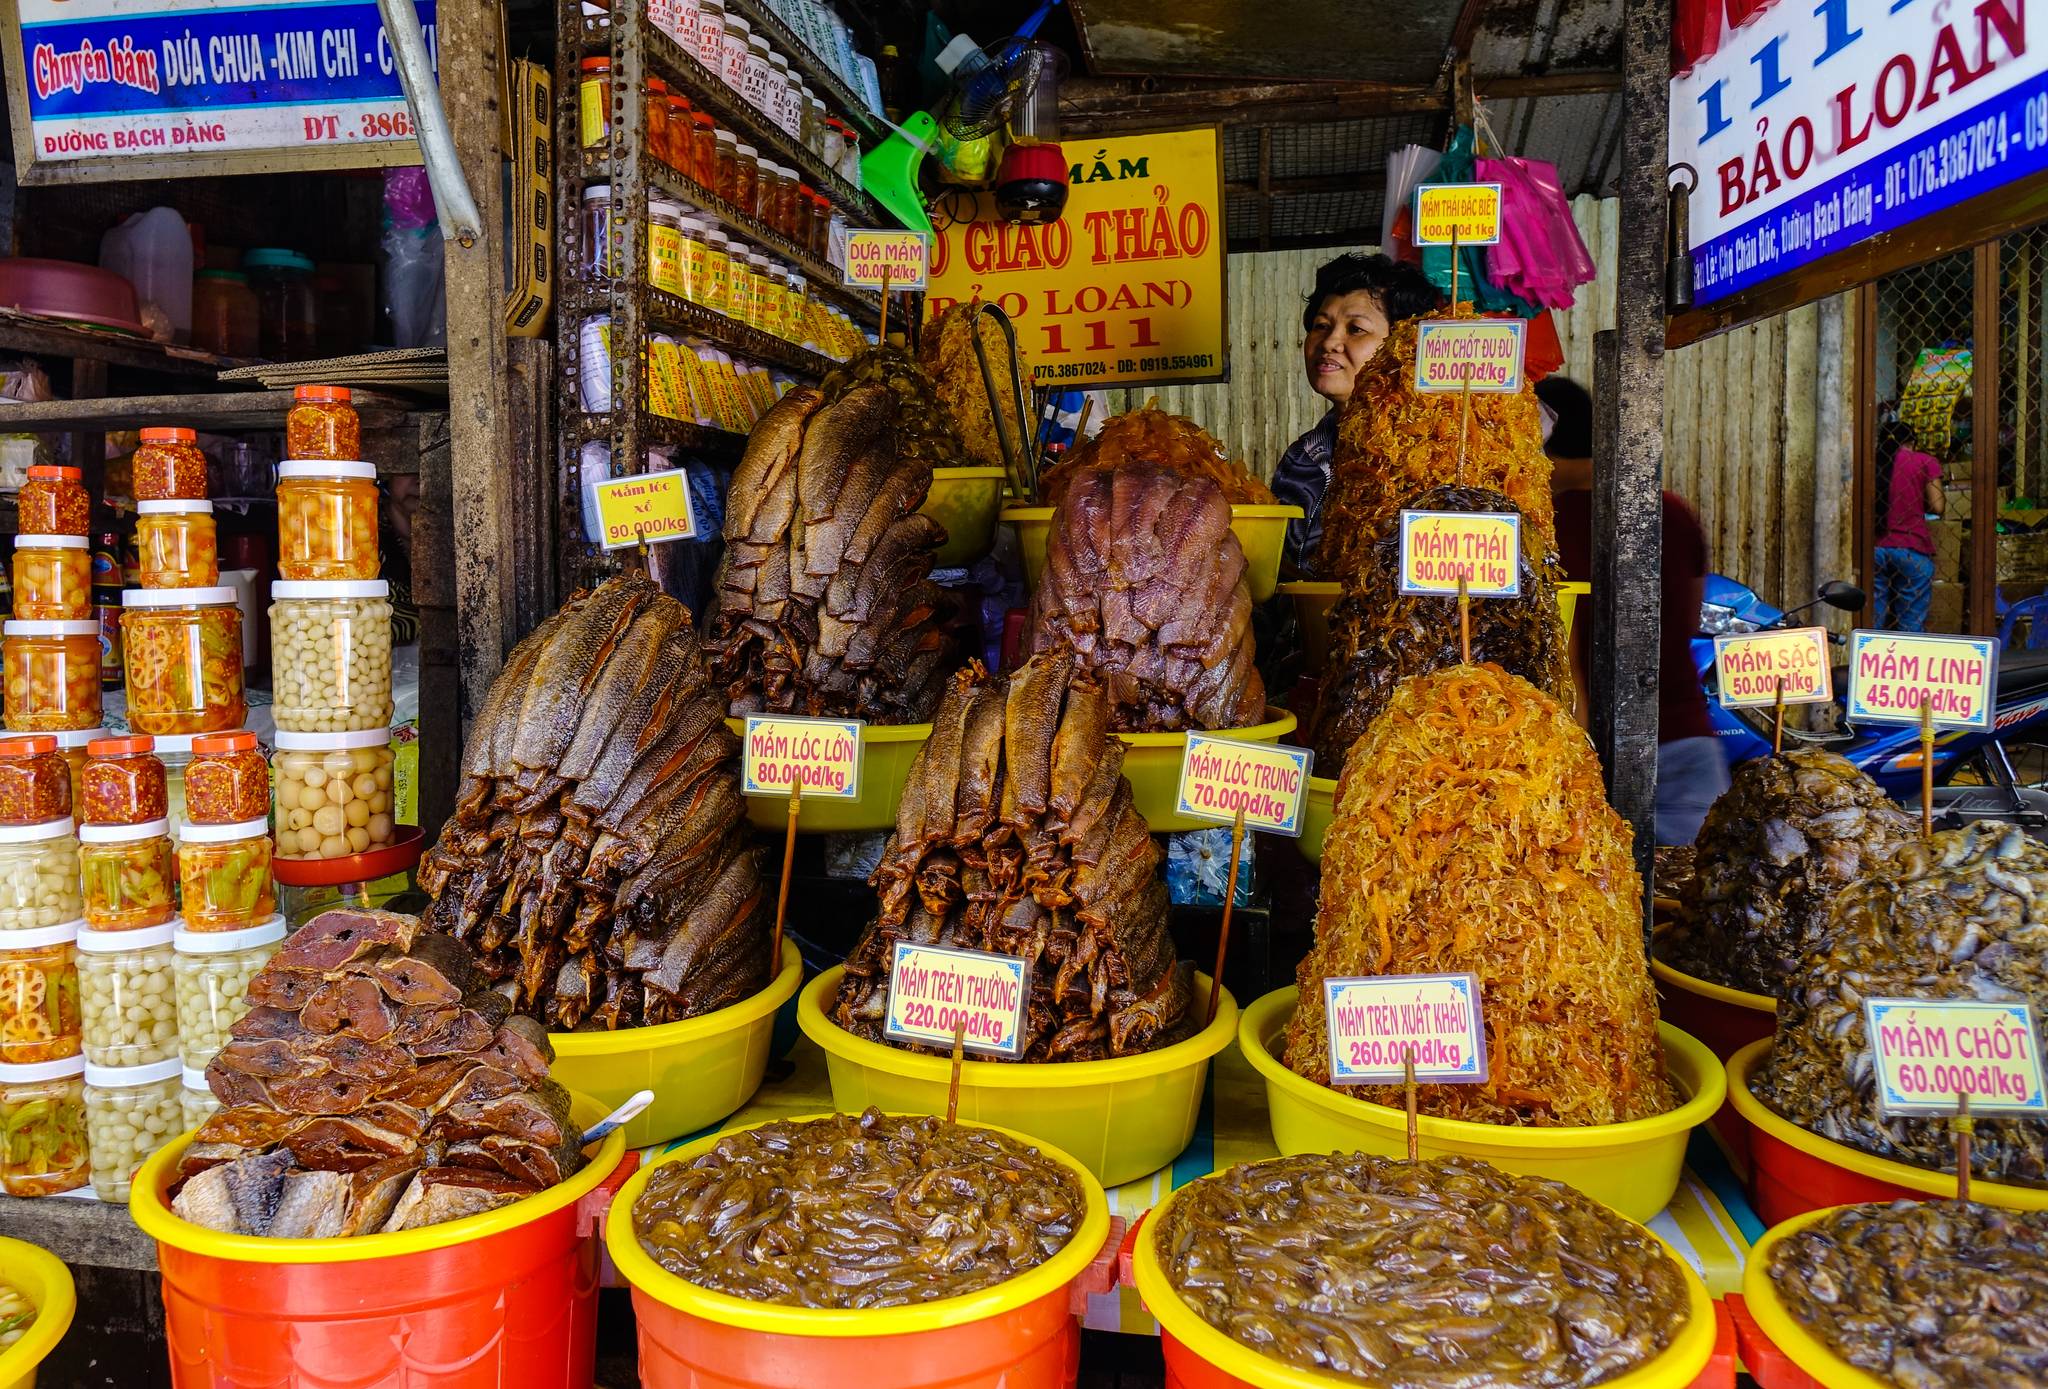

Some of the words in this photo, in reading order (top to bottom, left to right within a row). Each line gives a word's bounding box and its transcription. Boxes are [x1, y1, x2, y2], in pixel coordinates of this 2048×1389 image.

[35, 38, 109, 99] Chuyên
[209, 31, 265, 84] CHUA
[321, 28, 359, 79] CHI
[1718, 116, 1814, 218] BẢO
[1837, 0, 2027, 156] LOAN
[44, 128, 109, 153] ĐƯỜNG
[113, 127, 165, 151] BẠCH
[172, 117, 226, 145] ĐẰNG
[1068, 149, 1150, 185] MẮM
[1735, 232, 1757, 274] Châu
[1814, 191, 1841, 248] Bạch
[1909, 110, 2008, 201] 076.3867024
[1083, 184, 1210, 266] THẢO
[1423, 223, 1472, 237] 100.00đ
[1475, 223, 1495, 237] 1kg
[850, 241, 881, 261] DƯA
[885, 236, 922, 262] MẮM
[1043, 280, 1192, 316] LOAN)
[1425, 329, 1451, 359] MẮM
[1452, 329, 1480, 359] CHỐT
[1482, 338, 1497, 359] ĐU
[1034, 360, 1106, 380] 076.3867024
[1140, 353, 1214, 373] 0919.554961
[609, 517, 688, 539] 90.000/kg
[1413, 519, 1458, 559] MẮM
[1463, 527, 1508, 561] THÁI
[1479, 562, 1507, 588] 1kg
[1723, 641, 1772, 674] MẮM
[1778, 642, 1818, 673] SẶC
[1860, 641, 1920, 682] MẮM
[1926, 656, 1984, 686] LINH
[752, 724, 788, 759] MẮM
[792, 731, 821, 761] LÓC
[824, 733, 854, 763] LỚN
[1714, 728, 1747, 737] ONDA
[758, 762, 845, 791] 80.000đ/kg
[1188, 743, 1222, 782] MẮM
[1223, 754, 1251, 786] LÓC
[1254, 763, 1299, 794] TRUNG
[1194, 783, 1286, 823] 70.000đ/kg
[897, 952, 928, 999] MẮM
[931, 964, 964, 1004] TRÈN
[967, 970, 1017, 1013] THƯỜNG
[903, 1001, 1003, 1044] 220.000đ/kg
[1337, 991, 1366, 1037] MẮM
[1367, 995, 1398, 1036] TRÈN
[1401, 989, 1431, 1036] XUẤT
[1434, 987, 1467, 1034] KHẨU
[1350, 1038, 1461, 1069] 260.000đ/kg
[1880, 1010, 1949, 1058] MẮM
[1956, 1013, 2028, 1060] CHỐT
[1898, 1063, 2028, 1102] 60.000đ/kg
